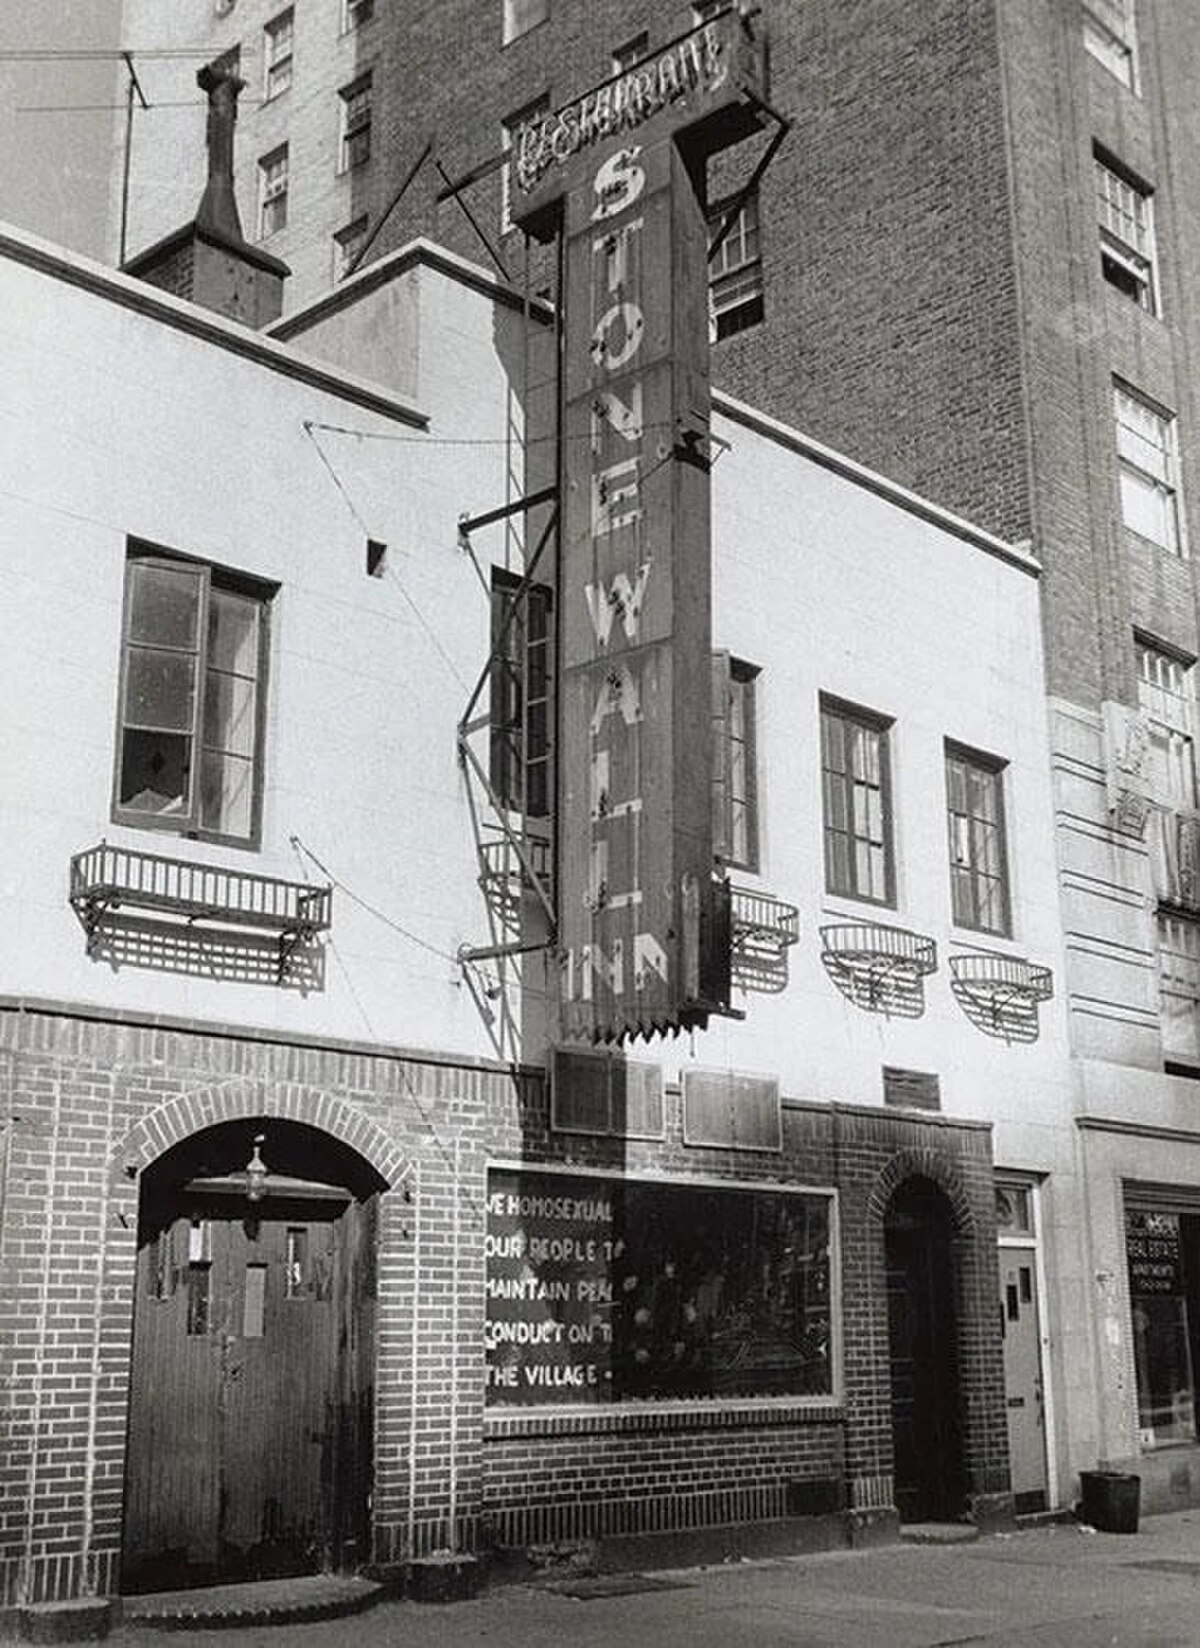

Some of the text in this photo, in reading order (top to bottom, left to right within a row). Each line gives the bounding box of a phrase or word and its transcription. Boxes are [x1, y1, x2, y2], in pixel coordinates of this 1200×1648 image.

[585, 145, 652, 912] STONEWALL
[562, 932, 670, 1002] INN
[484, 1234, 523, 1259] OUR
[530, 1238, 596, 1262] PEOPLE
[568, 1324, 593, 1344] ON
[484, 1364, 597, 1387] THE VILLAGE
